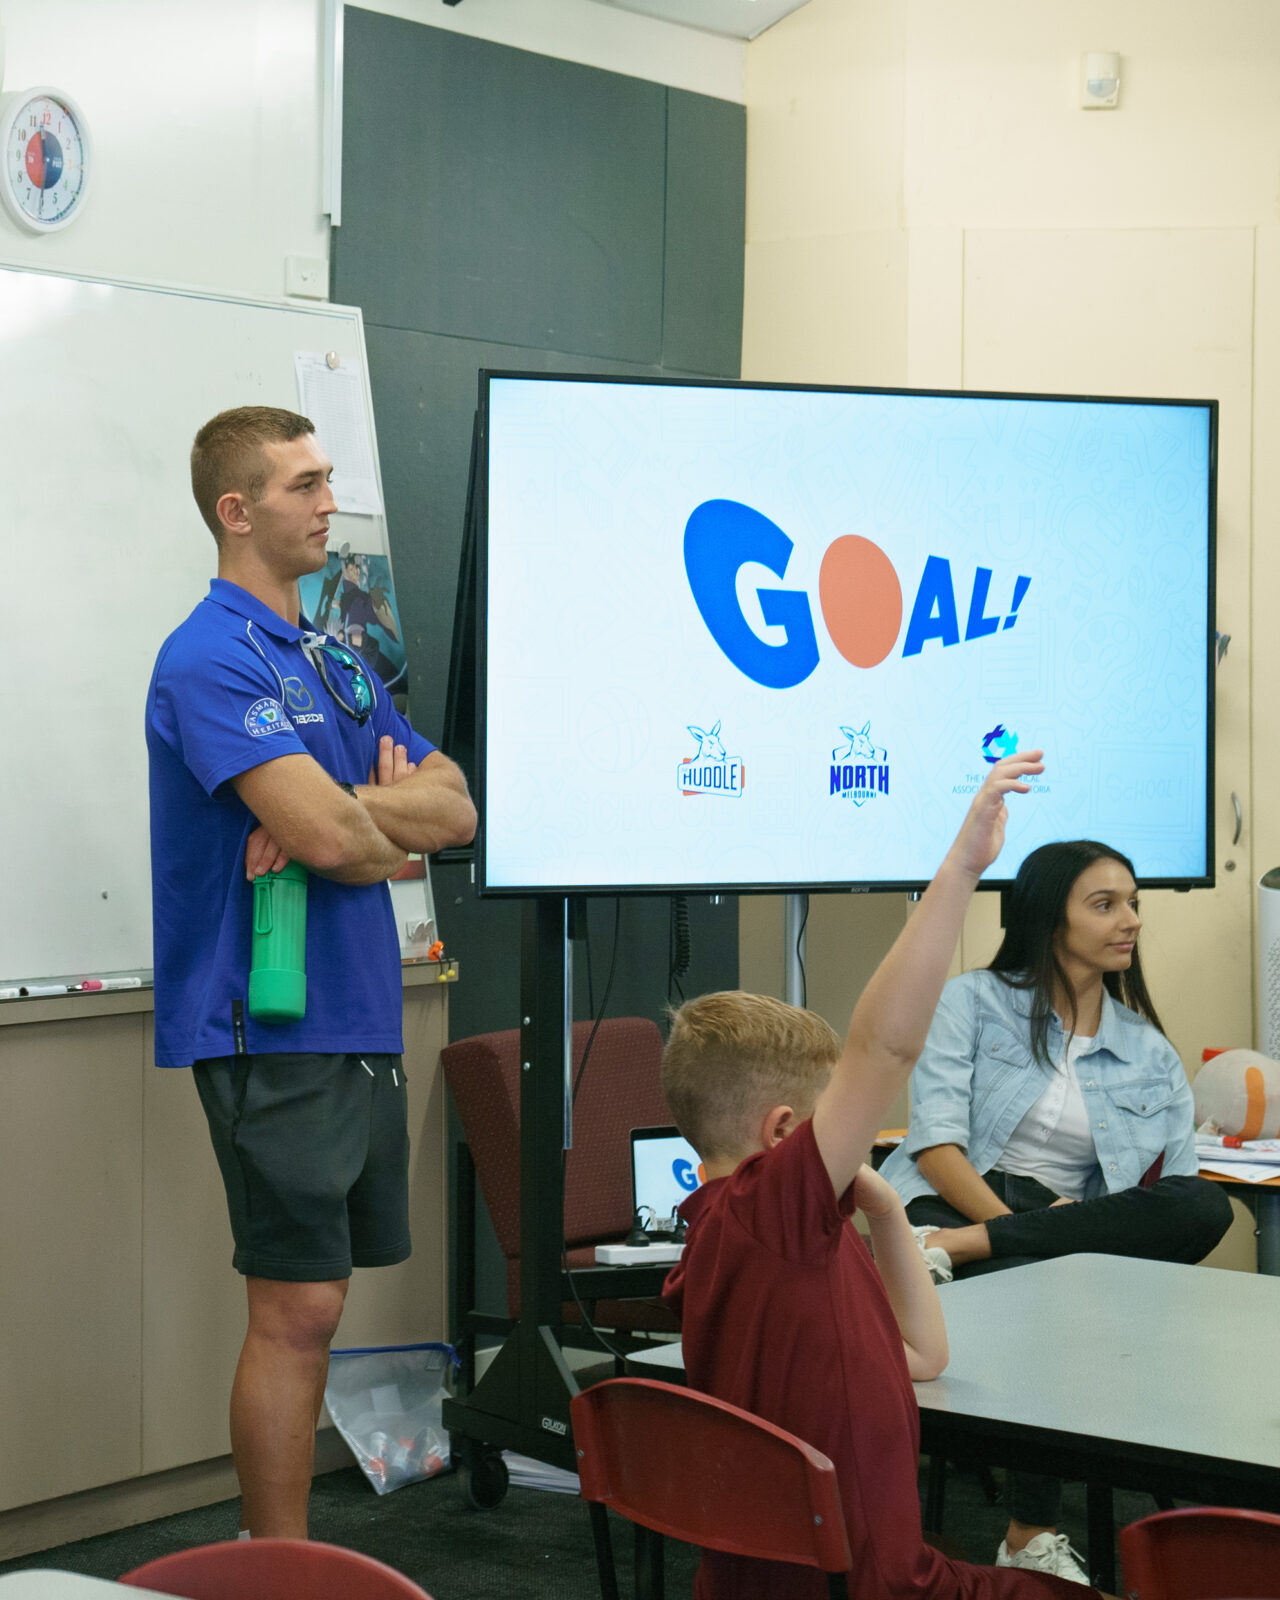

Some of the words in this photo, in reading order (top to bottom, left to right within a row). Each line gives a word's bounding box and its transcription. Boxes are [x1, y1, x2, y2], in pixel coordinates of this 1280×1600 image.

[683, 498, 1033, 689] GOAL!
[683, 764, 738, 790] HUDDLE
[830, 765, 889, 796] NORTH
